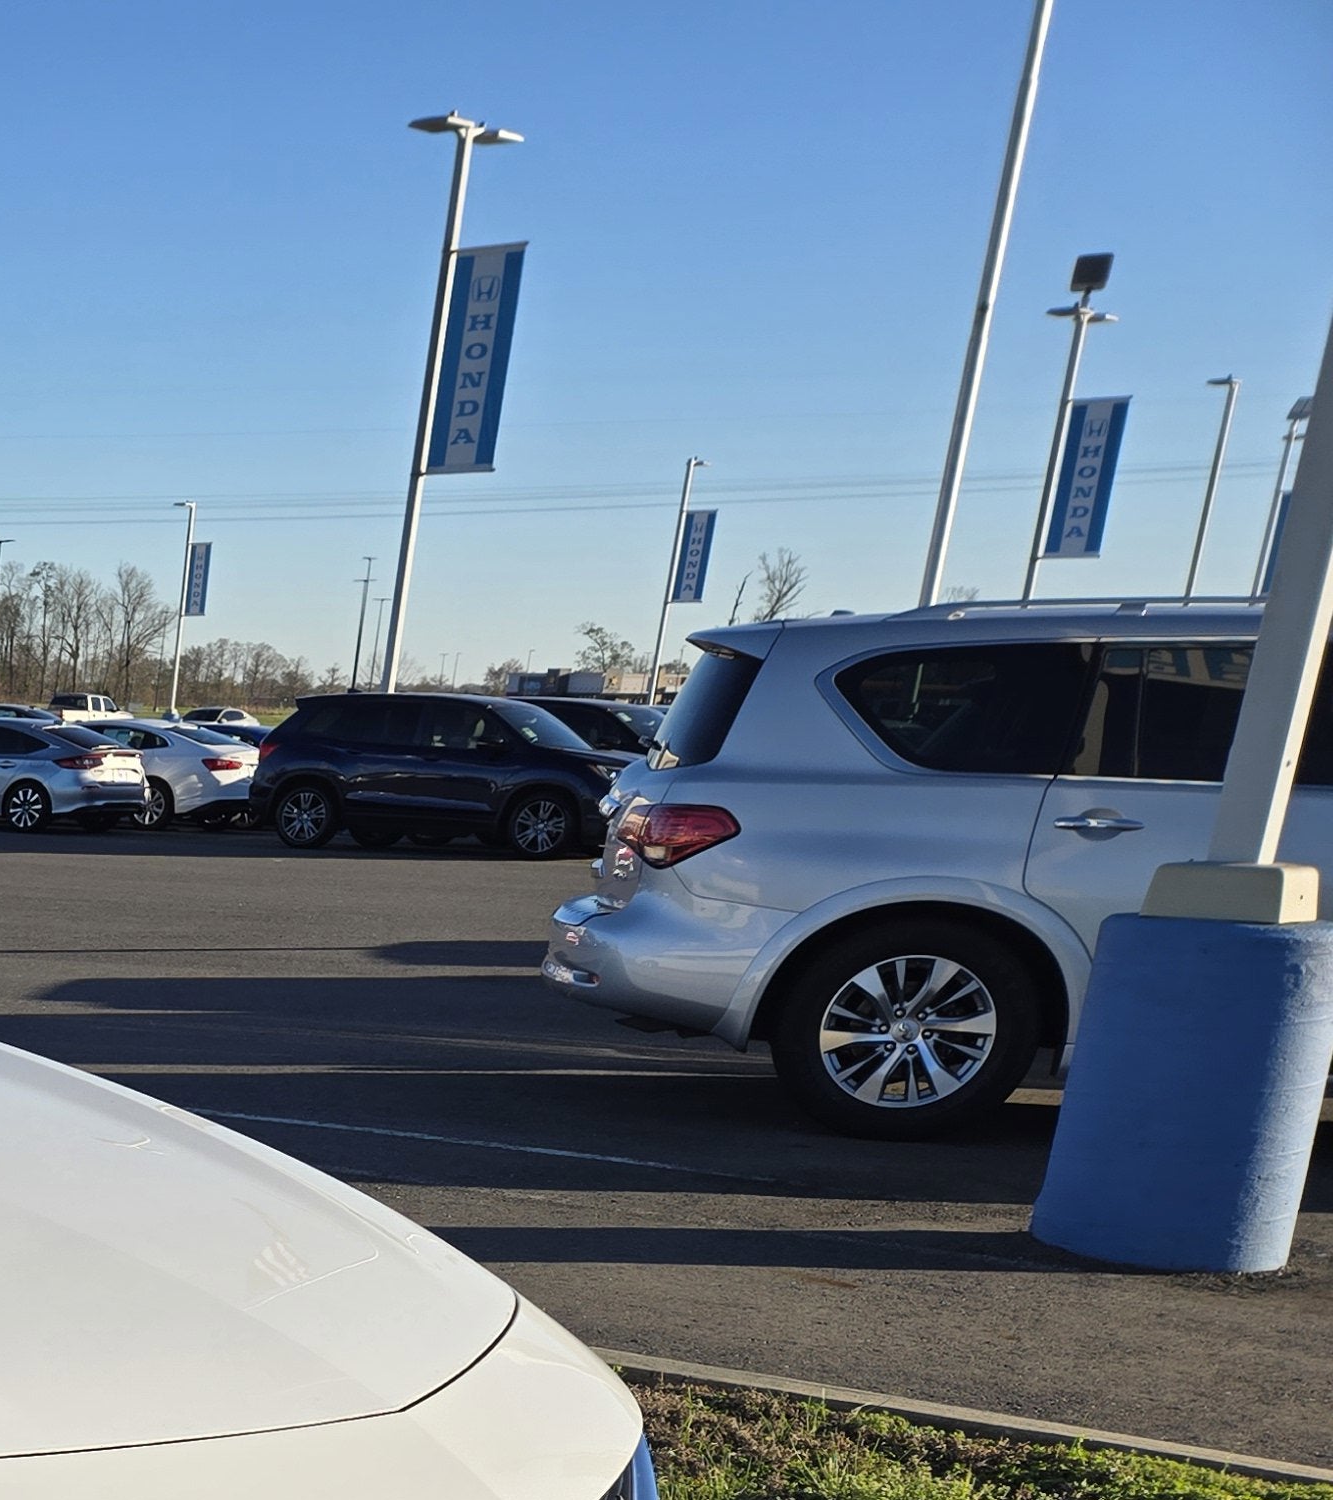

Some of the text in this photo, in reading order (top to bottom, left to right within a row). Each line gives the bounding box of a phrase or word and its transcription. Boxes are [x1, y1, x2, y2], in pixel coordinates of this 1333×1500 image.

[450, 314, 494, 446] HONDA
[1065, 446, 1102, 538] HONDA
[683, 538, 702, 592] HONDA
